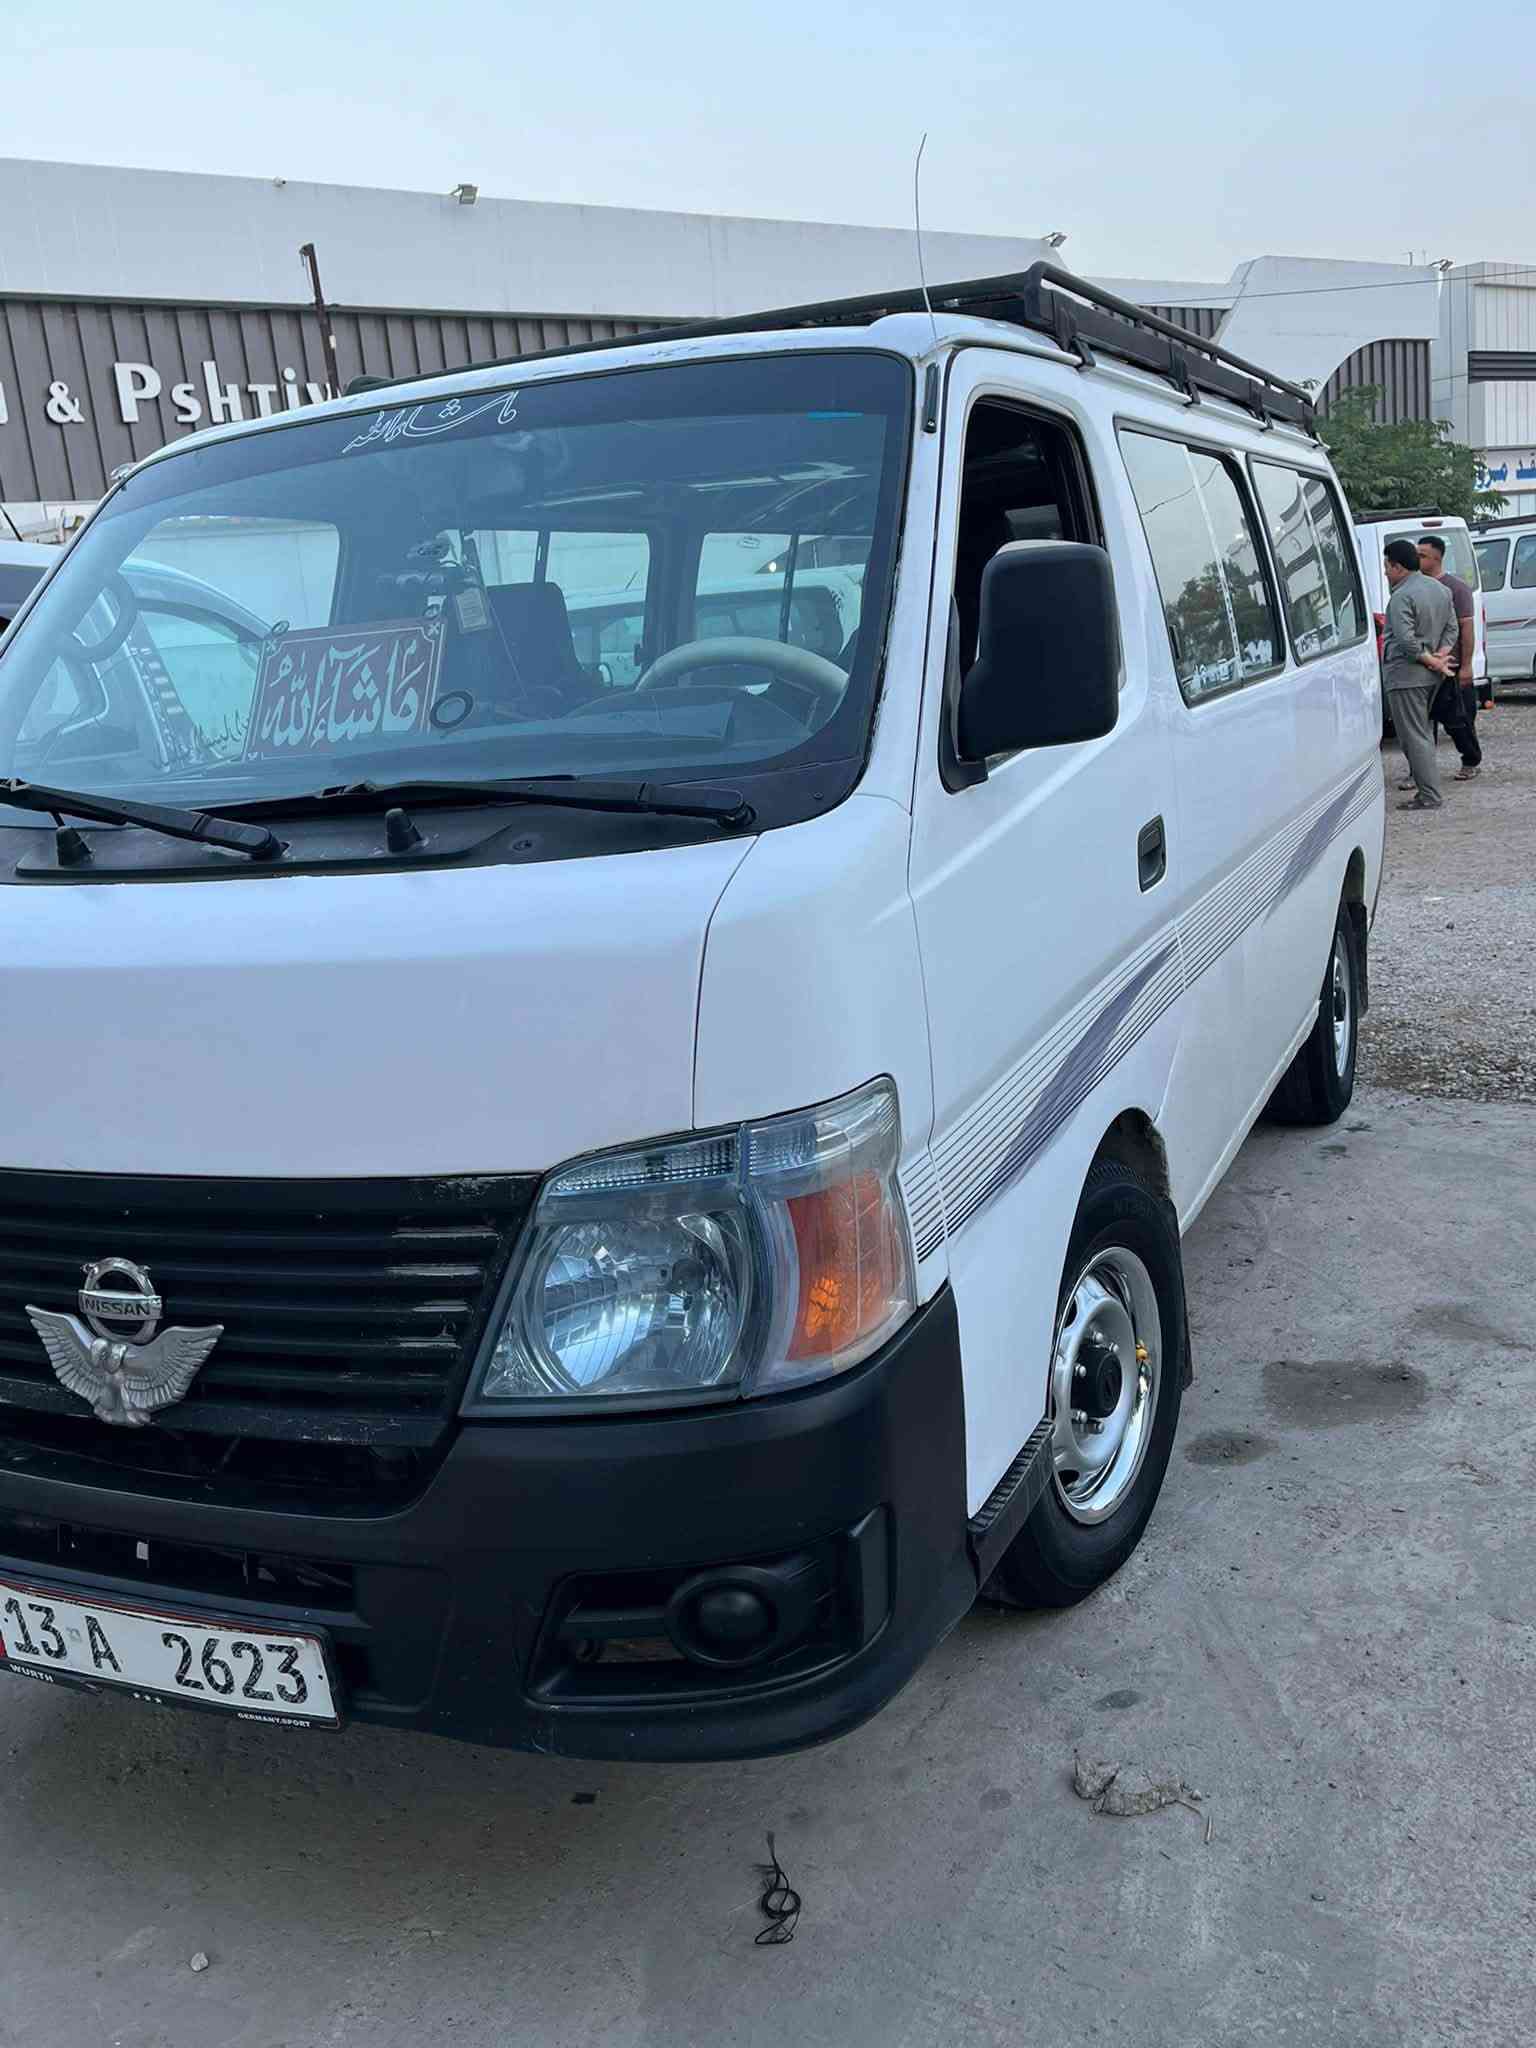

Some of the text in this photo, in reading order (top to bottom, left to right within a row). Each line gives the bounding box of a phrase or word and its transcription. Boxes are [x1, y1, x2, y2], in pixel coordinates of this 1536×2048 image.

[46, 381, 85, 423] &
[84, 1297, 151, 1316] NISSAN
[5, 1597, 308, 1705] 13 A 2623
